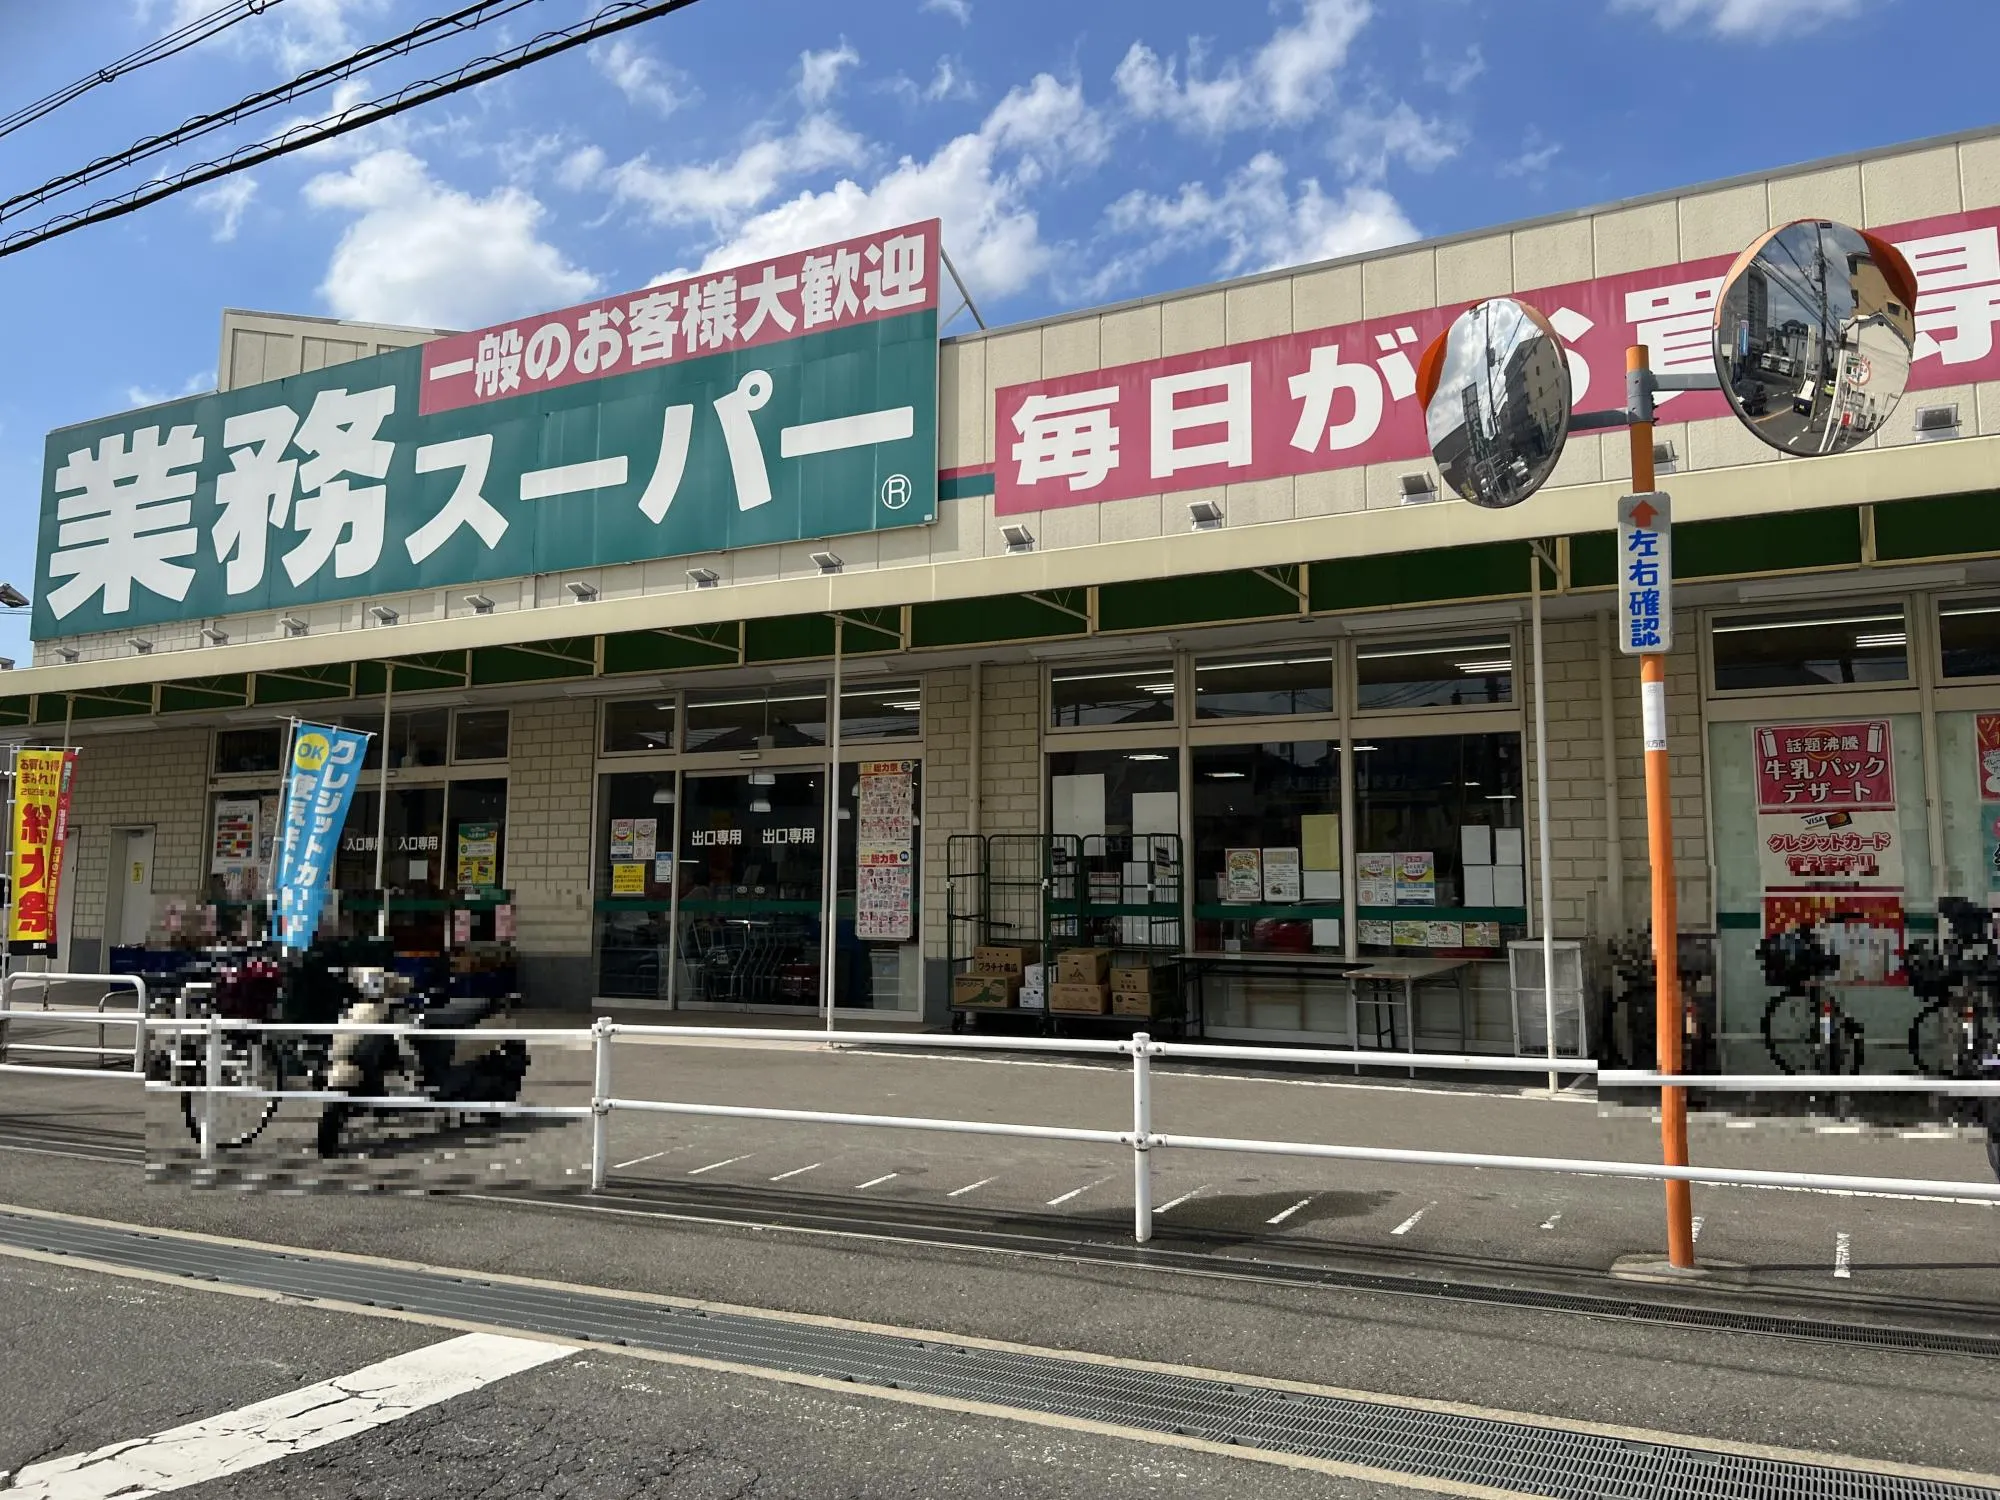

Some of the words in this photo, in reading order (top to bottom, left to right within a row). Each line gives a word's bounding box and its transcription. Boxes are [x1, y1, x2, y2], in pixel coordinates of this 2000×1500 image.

[429, 233, 927, 398] 一般のお客様大歓迎
[46, 369, 914, 621] 業務スーパー
[1628, 530, 1661, 647] 左右確認
[297, 742, 325, 761] OK
[1785, 736, 1860, 753] 話題沸騰
[1764, 756, 1886, 781] 牛乳パック
[1782, 781, 1872, 803] デザート
[1805, 815, 1825, 826] VISA
[292, 739, 357, 931] クレジットカ
[398, 836, 438, 850] 入口専用
[691, 829, 742, 846] 出口専用
[762, 828, 815, 844] 出口専用
[1767, 832, 1891, 852] クレジットカード
